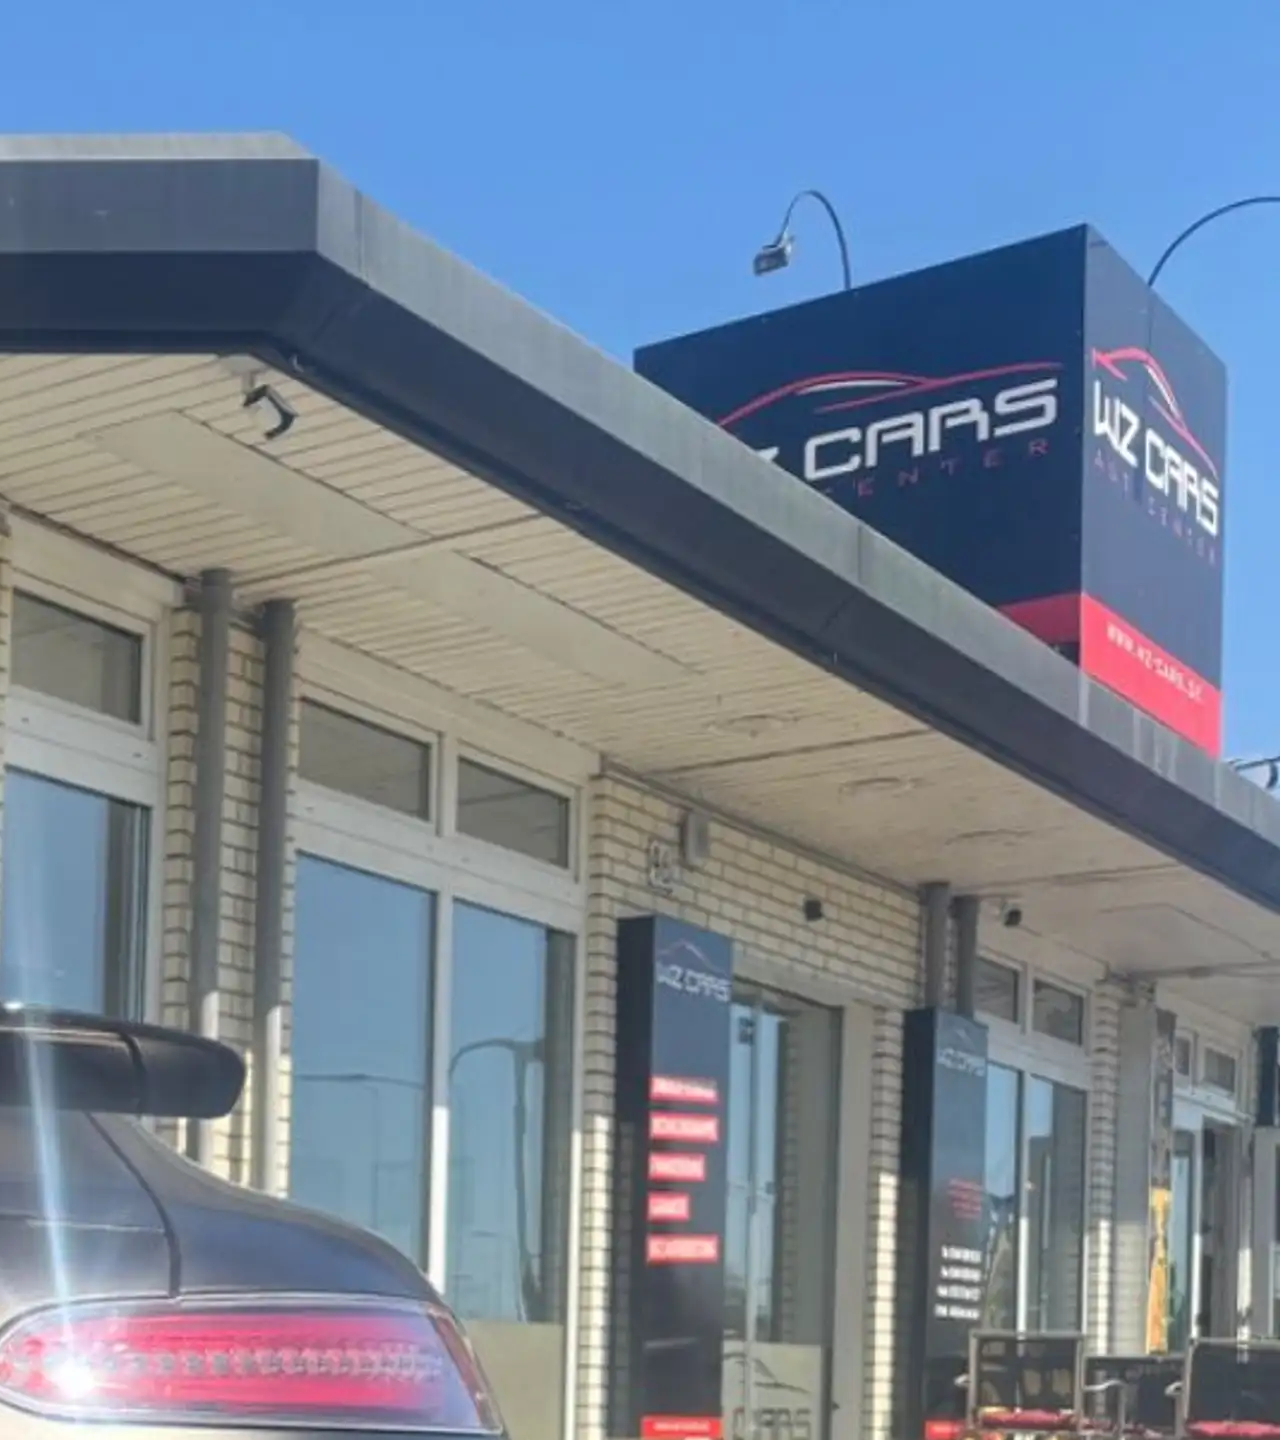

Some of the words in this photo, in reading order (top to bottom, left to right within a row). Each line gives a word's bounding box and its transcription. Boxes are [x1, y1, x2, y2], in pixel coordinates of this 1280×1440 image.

[804, 377, 1059, 481] CARS
[824, 437, 1051, 498] ENTER
[1092, 378, 1140, 470] WZ
[1144, 427, 1219, 538] CARS
